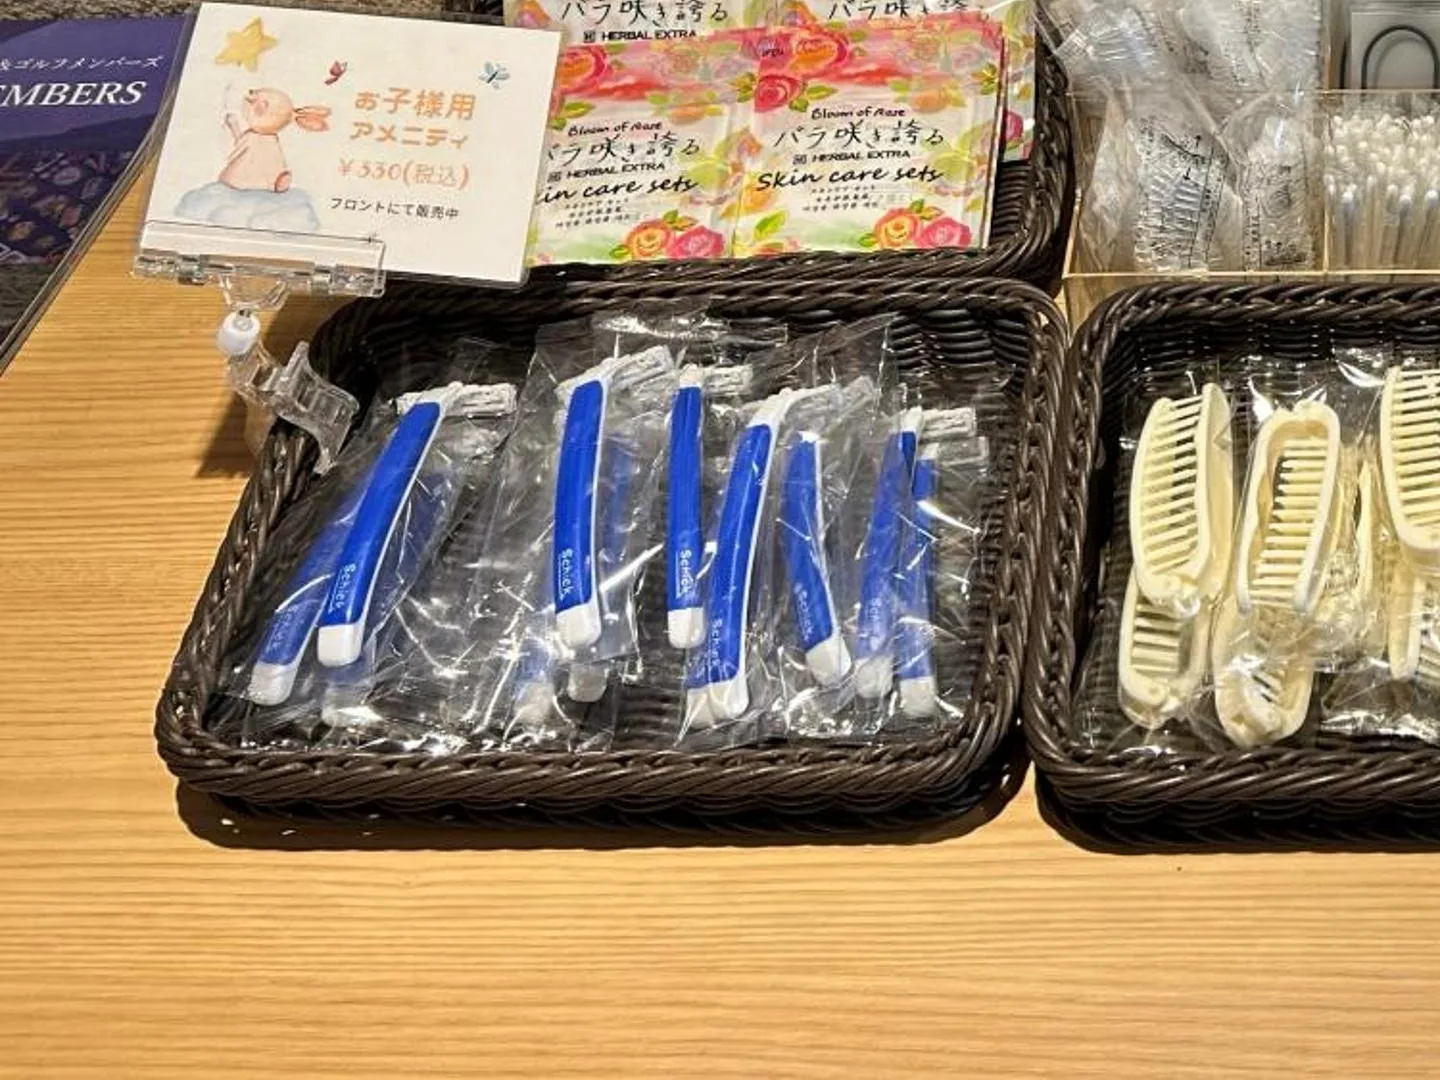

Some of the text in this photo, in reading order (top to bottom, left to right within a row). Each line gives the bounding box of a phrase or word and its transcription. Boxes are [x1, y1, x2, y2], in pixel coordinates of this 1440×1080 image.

[602, 30, 652, 41] HERBAL
[655, 29, 698, 40] EXTRA
[354, 87, 477, 121] お子様用
[811, 107, 854, 120] Bloom
[856, 106, 872, 117] of
[350, 121, 469, 150] アメニティ
[567, 124, 610, 137] Bloom
[613, 122, 629, 133] of
[773, 118, 944, 150] バラ咲き誇る
[621, 163, 666, 173] EXTRA
[866, 150, 911, 160] EXTRA
[536, 185, 578, 205] in
[582, 179, 643, 197] care
[647, 175, 700, 194] sets
[756, 170, 824, 192] Skin
[828, 167, 890, 184] care
[893, 165, 945, 182] sets
[330, 197, 460, 220] フロントにて販売中
[330, 562, 357, 611] Schick
[559, 548, 575, 597] Schick
[677, 549, 695, 598] Schick
